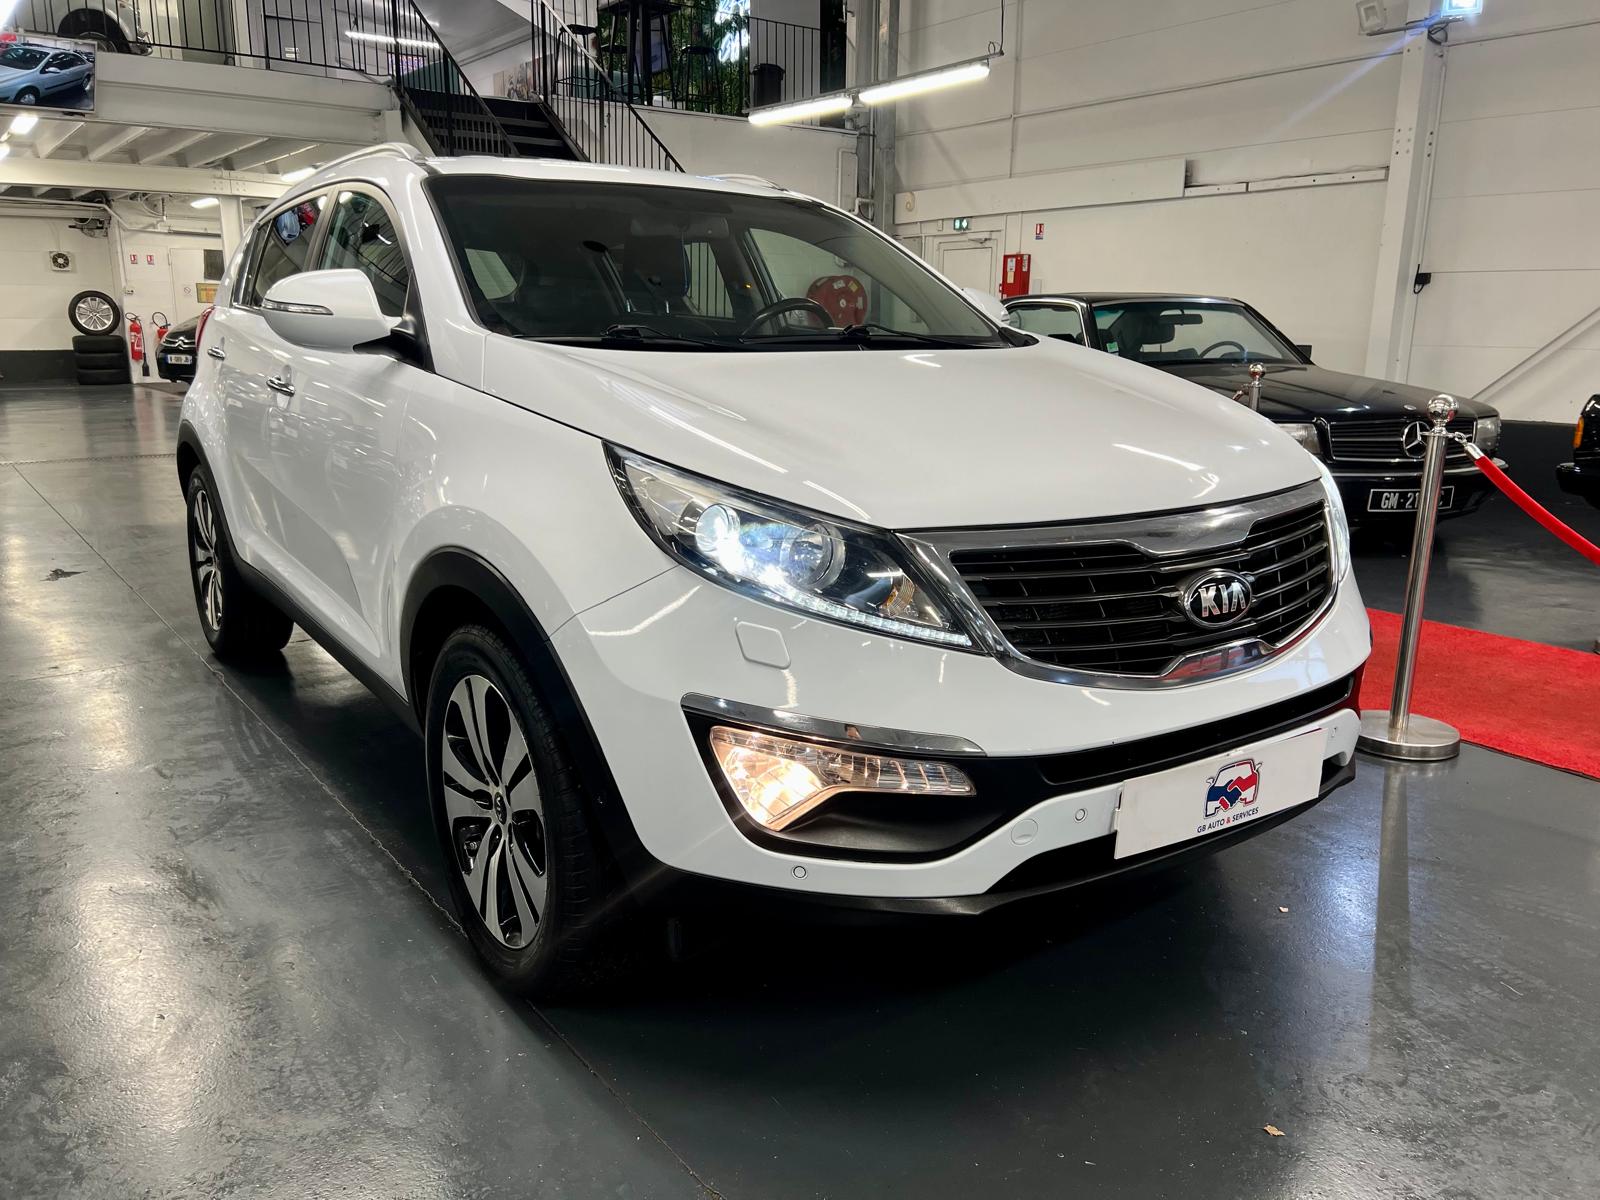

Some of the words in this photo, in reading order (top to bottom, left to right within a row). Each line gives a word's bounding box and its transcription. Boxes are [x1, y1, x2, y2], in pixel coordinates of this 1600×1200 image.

[1198, 582, 1247, 618] KIA
[1197, 824, 1207, 833] GB
[1207, 818, 1225, 830] AUTO
[1232, 806, 1260, 822] SERVICES
